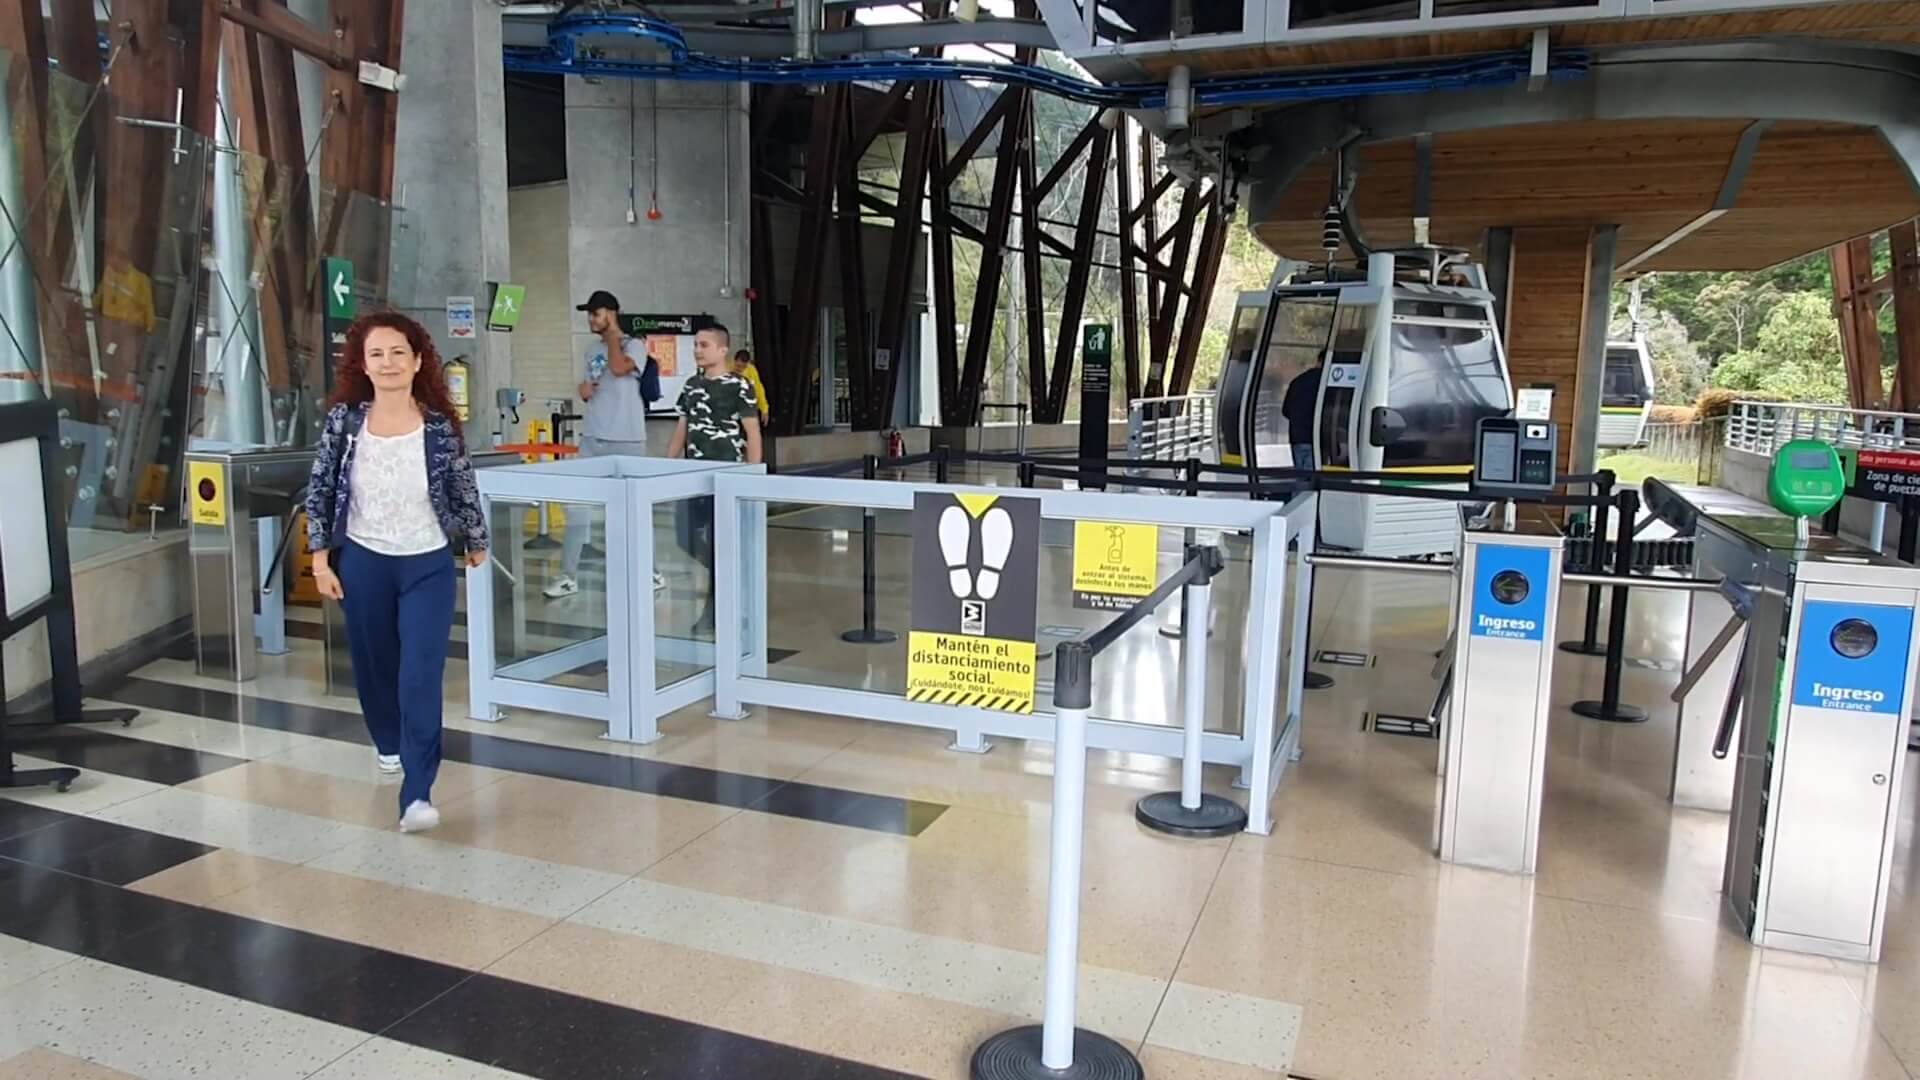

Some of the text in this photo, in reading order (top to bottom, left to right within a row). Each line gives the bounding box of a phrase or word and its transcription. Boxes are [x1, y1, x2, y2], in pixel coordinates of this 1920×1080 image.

[1875, 456, 1907, 465] personal
[1866, 470, 1890, 482] Zona
[1892, 473, 1905, 483] de
[1873, 482, 1887, 491] de
[1099, 564, 1131, 573] Antes de
[1108, 571, 1115, 579] al
[1075, 578, 1153, 590] desinfecta tus manos
[1478, 614, 1536, 631] Ingreso
[1486, 628, 1526, 638] Entrance
[936, 637, 1009, 657] Mantén el
[912, 650, 1031, 675] distanciamiento
[949, 670, 995, 685] social.
[968, 684, 985, 693] nos
[987, 687, 1031, 699] cuidamos!
[1812, 682, 1885, 702] Ingreso
[1822, 698, 1872, 712] Entrance
